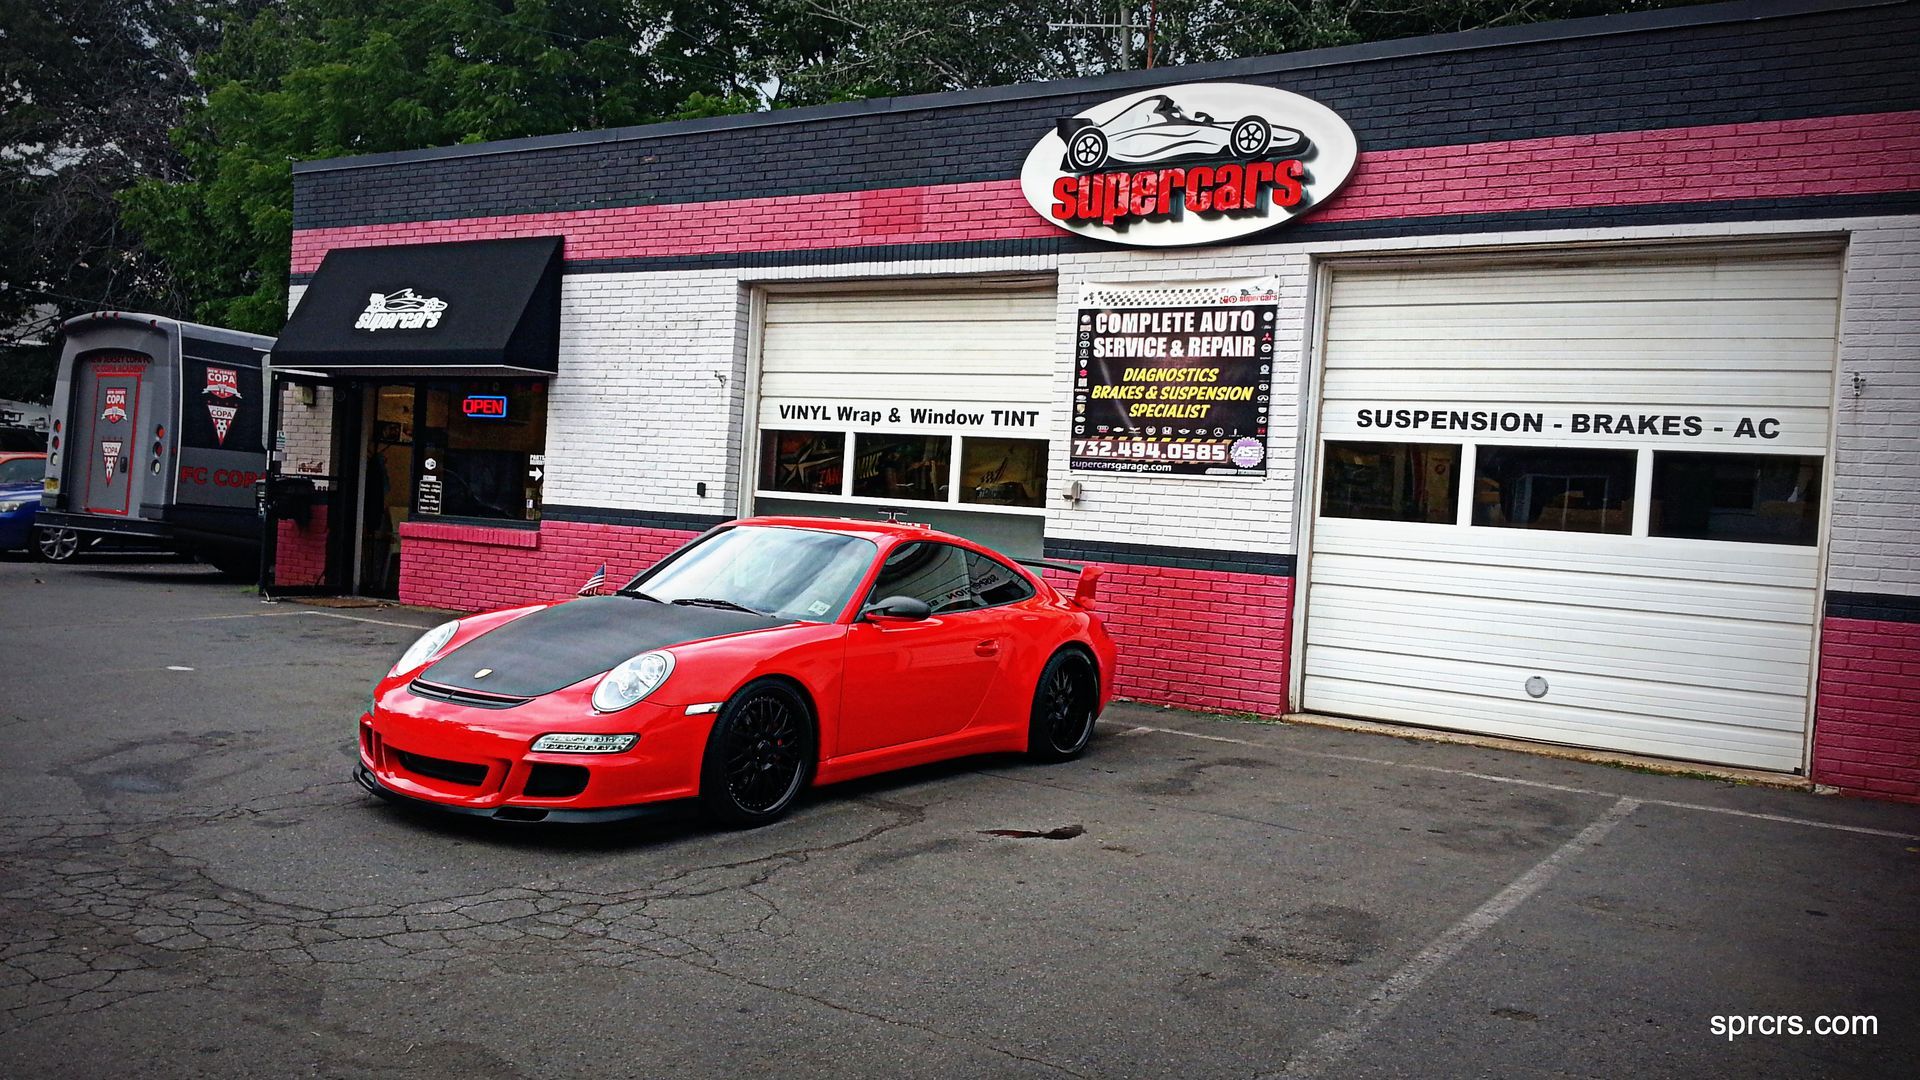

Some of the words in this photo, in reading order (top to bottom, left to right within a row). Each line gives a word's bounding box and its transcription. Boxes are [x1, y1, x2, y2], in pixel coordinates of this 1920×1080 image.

[1052, 159, 1304, 225] supercars
[354, 311, 442, 332] supercars
[1096, 312, 1195, 334] COMPLETE
[1200, 310, 1255, 332] AUTO
[1093, 337, 1168, 358] SERVICE
[1171, 339, 1184, 358] &
[1188, 336, 1256, 357] REPAIR
[208, 373, 236, 384] COPA
[1122, 367, 1220, 382] DIAGNOSTICS
[106, 395, 125, 404] COPA
[1091, 385, 1143, 400] BRAKES
[1145, 386, 1157, 400] &
[1160, 386, 1254, 401] SUSPENSION
[211, 409, 232, 418] COPA
[462, 399, 504, 414] OPEN
[1129, 403, 1211, 418] SPECIALIST
[779, 404, 831, 421] VINYL
[837, 406, 882, 426] Wrap
[888, 408, 901, 423] &
[910, 408, 984, 426] Window
[991, 410, 1039, 427] TINT
[1356, 409, 1543, 433] SUSPENSION
[1571, 413, 1702, 437] BRAKES
[1733, 417, 1781, 439] AC
[104, 446, 118, 454] COPA
[1073, 440, 1226, 460] 732.494.0585
[1235, 446, 1260, 457] ASE
[1071, 460, 1172, 472] supercarsgarage.com
[180, 466, 208, 486] FC
